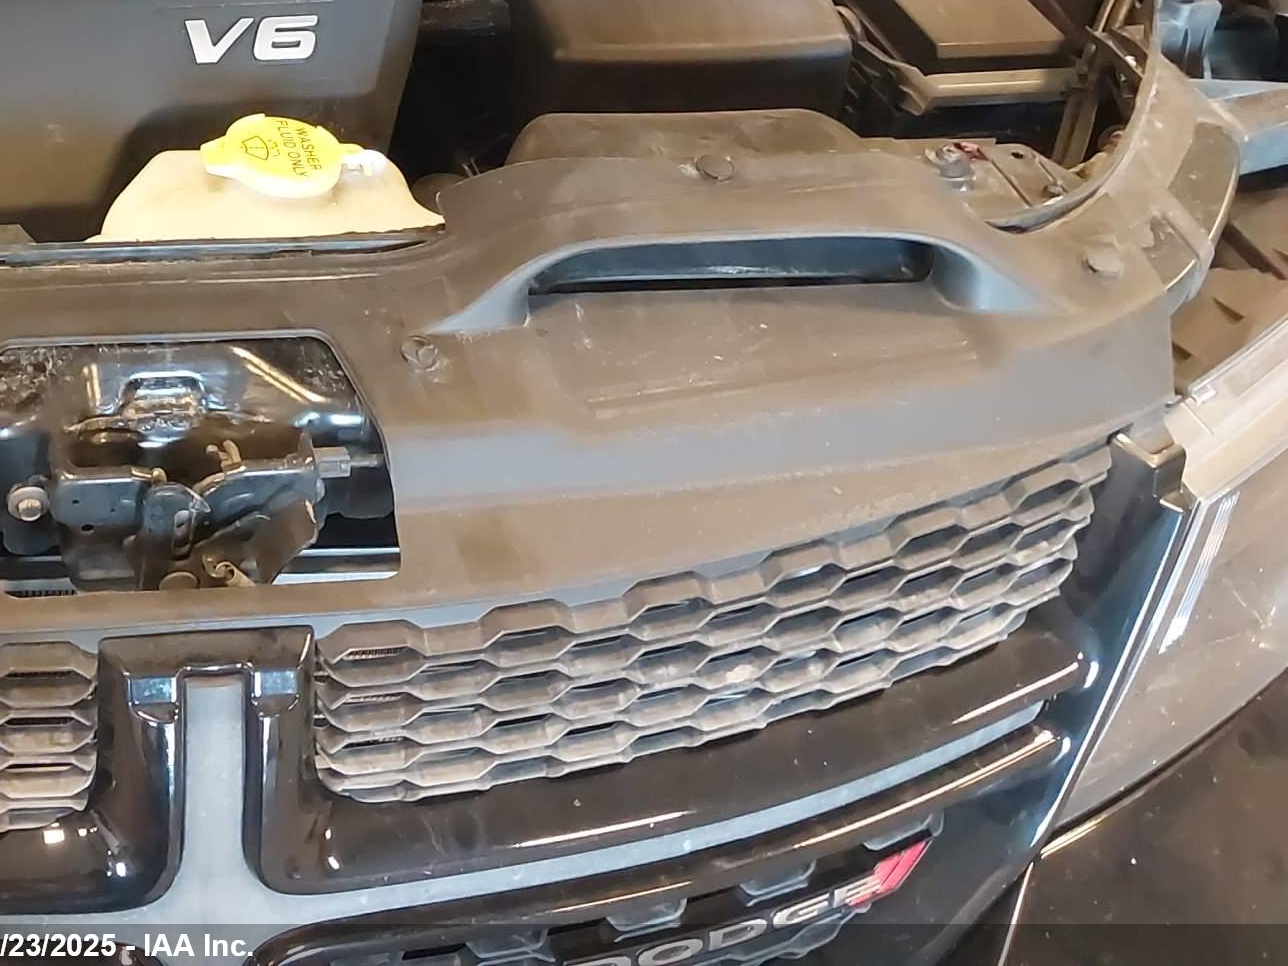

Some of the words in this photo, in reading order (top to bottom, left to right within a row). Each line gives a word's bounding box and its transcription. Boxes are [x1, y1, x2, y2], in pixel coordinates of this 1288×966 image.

[184, 15, 319, 65] V6
[275, 120, 297, 149] FLUID
[287, 151, 309, 178] ONLY
[295, 127, 323, 171] WASHER
